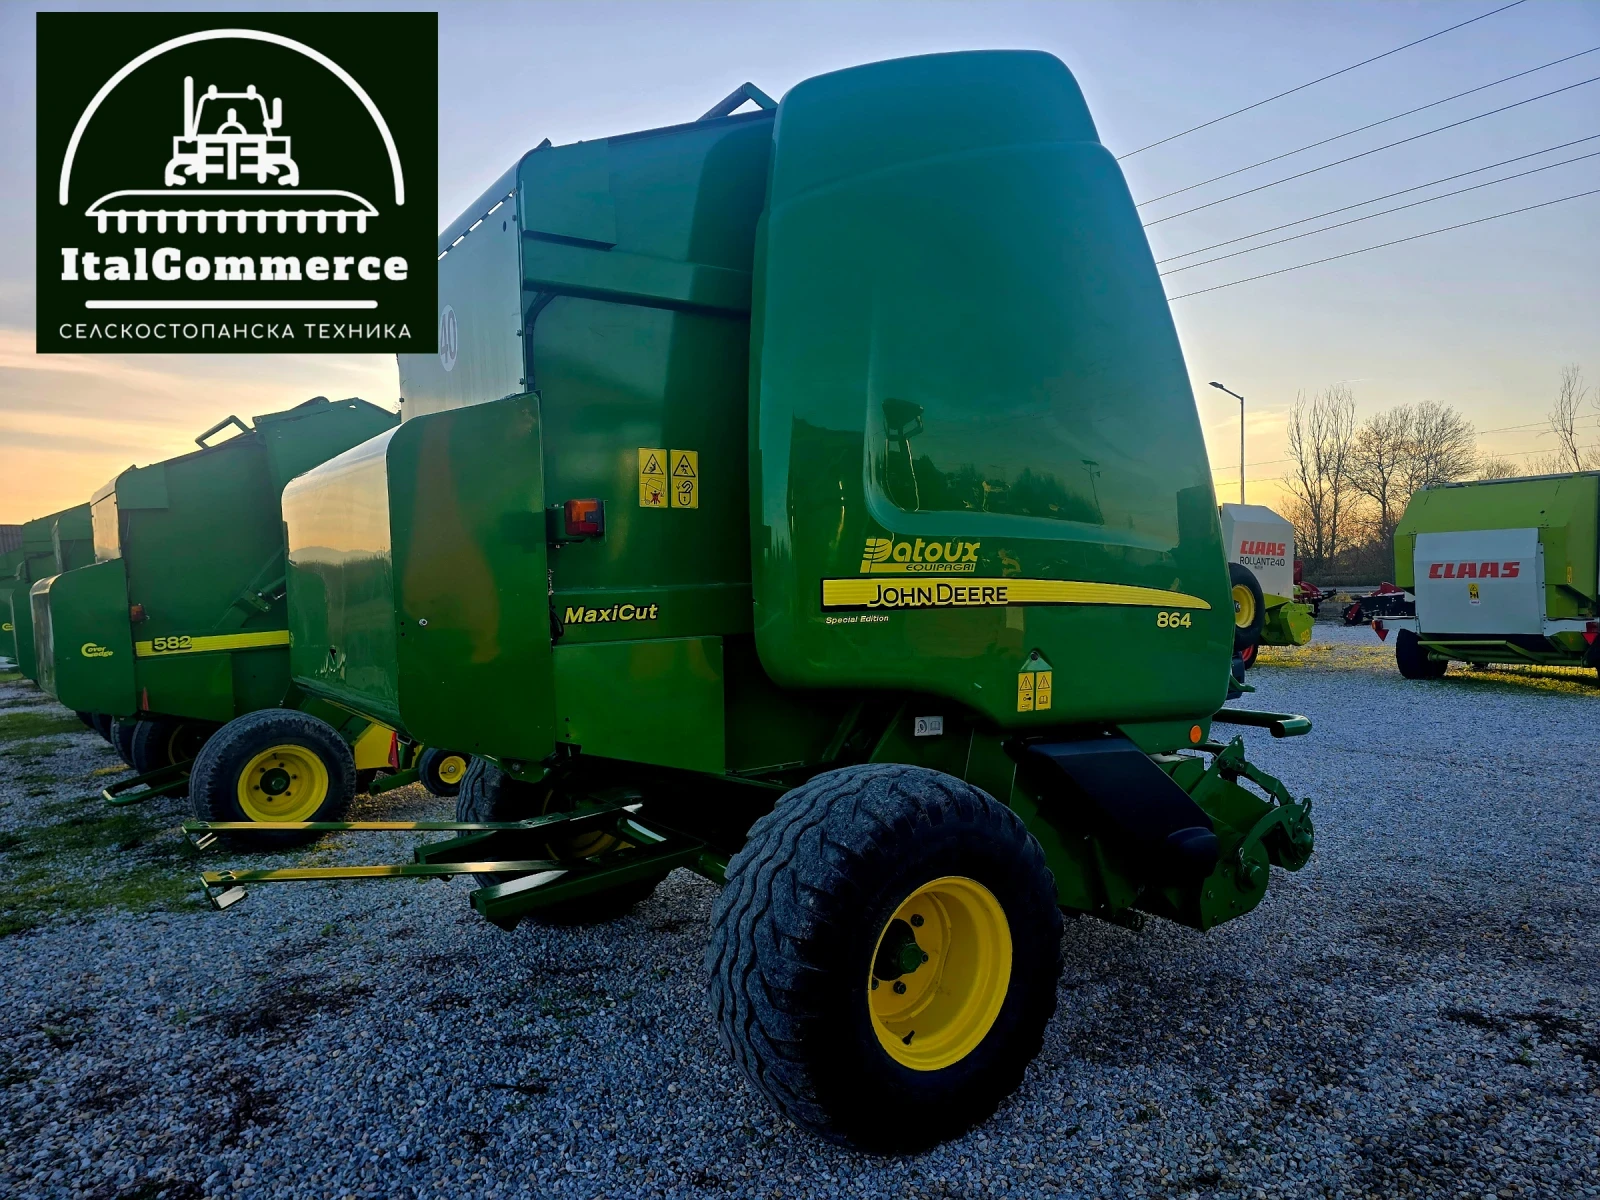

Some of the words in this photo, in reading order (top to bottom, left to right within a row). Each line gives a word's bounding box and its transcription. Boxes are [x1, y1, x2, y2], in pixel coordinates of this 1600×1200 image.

[441, 309, 457, 363] 40
[1240, 540, 1286, 556] CLAAS
[905, 563, 975, 572] EQUIPAGRI
[1428, 561, 1521, 579] CLAAS
[869, 584, 932, 605] JOHN
[936, 583, 1008, 603] DEERE
[564, 604, 658, 624] MaxiCut
[825, 616, 859, 625] Special
[860, 614, 889, 623] Edition
[1156, 611, 1192, 628] 864
[153, 635, 193, 651] 582
